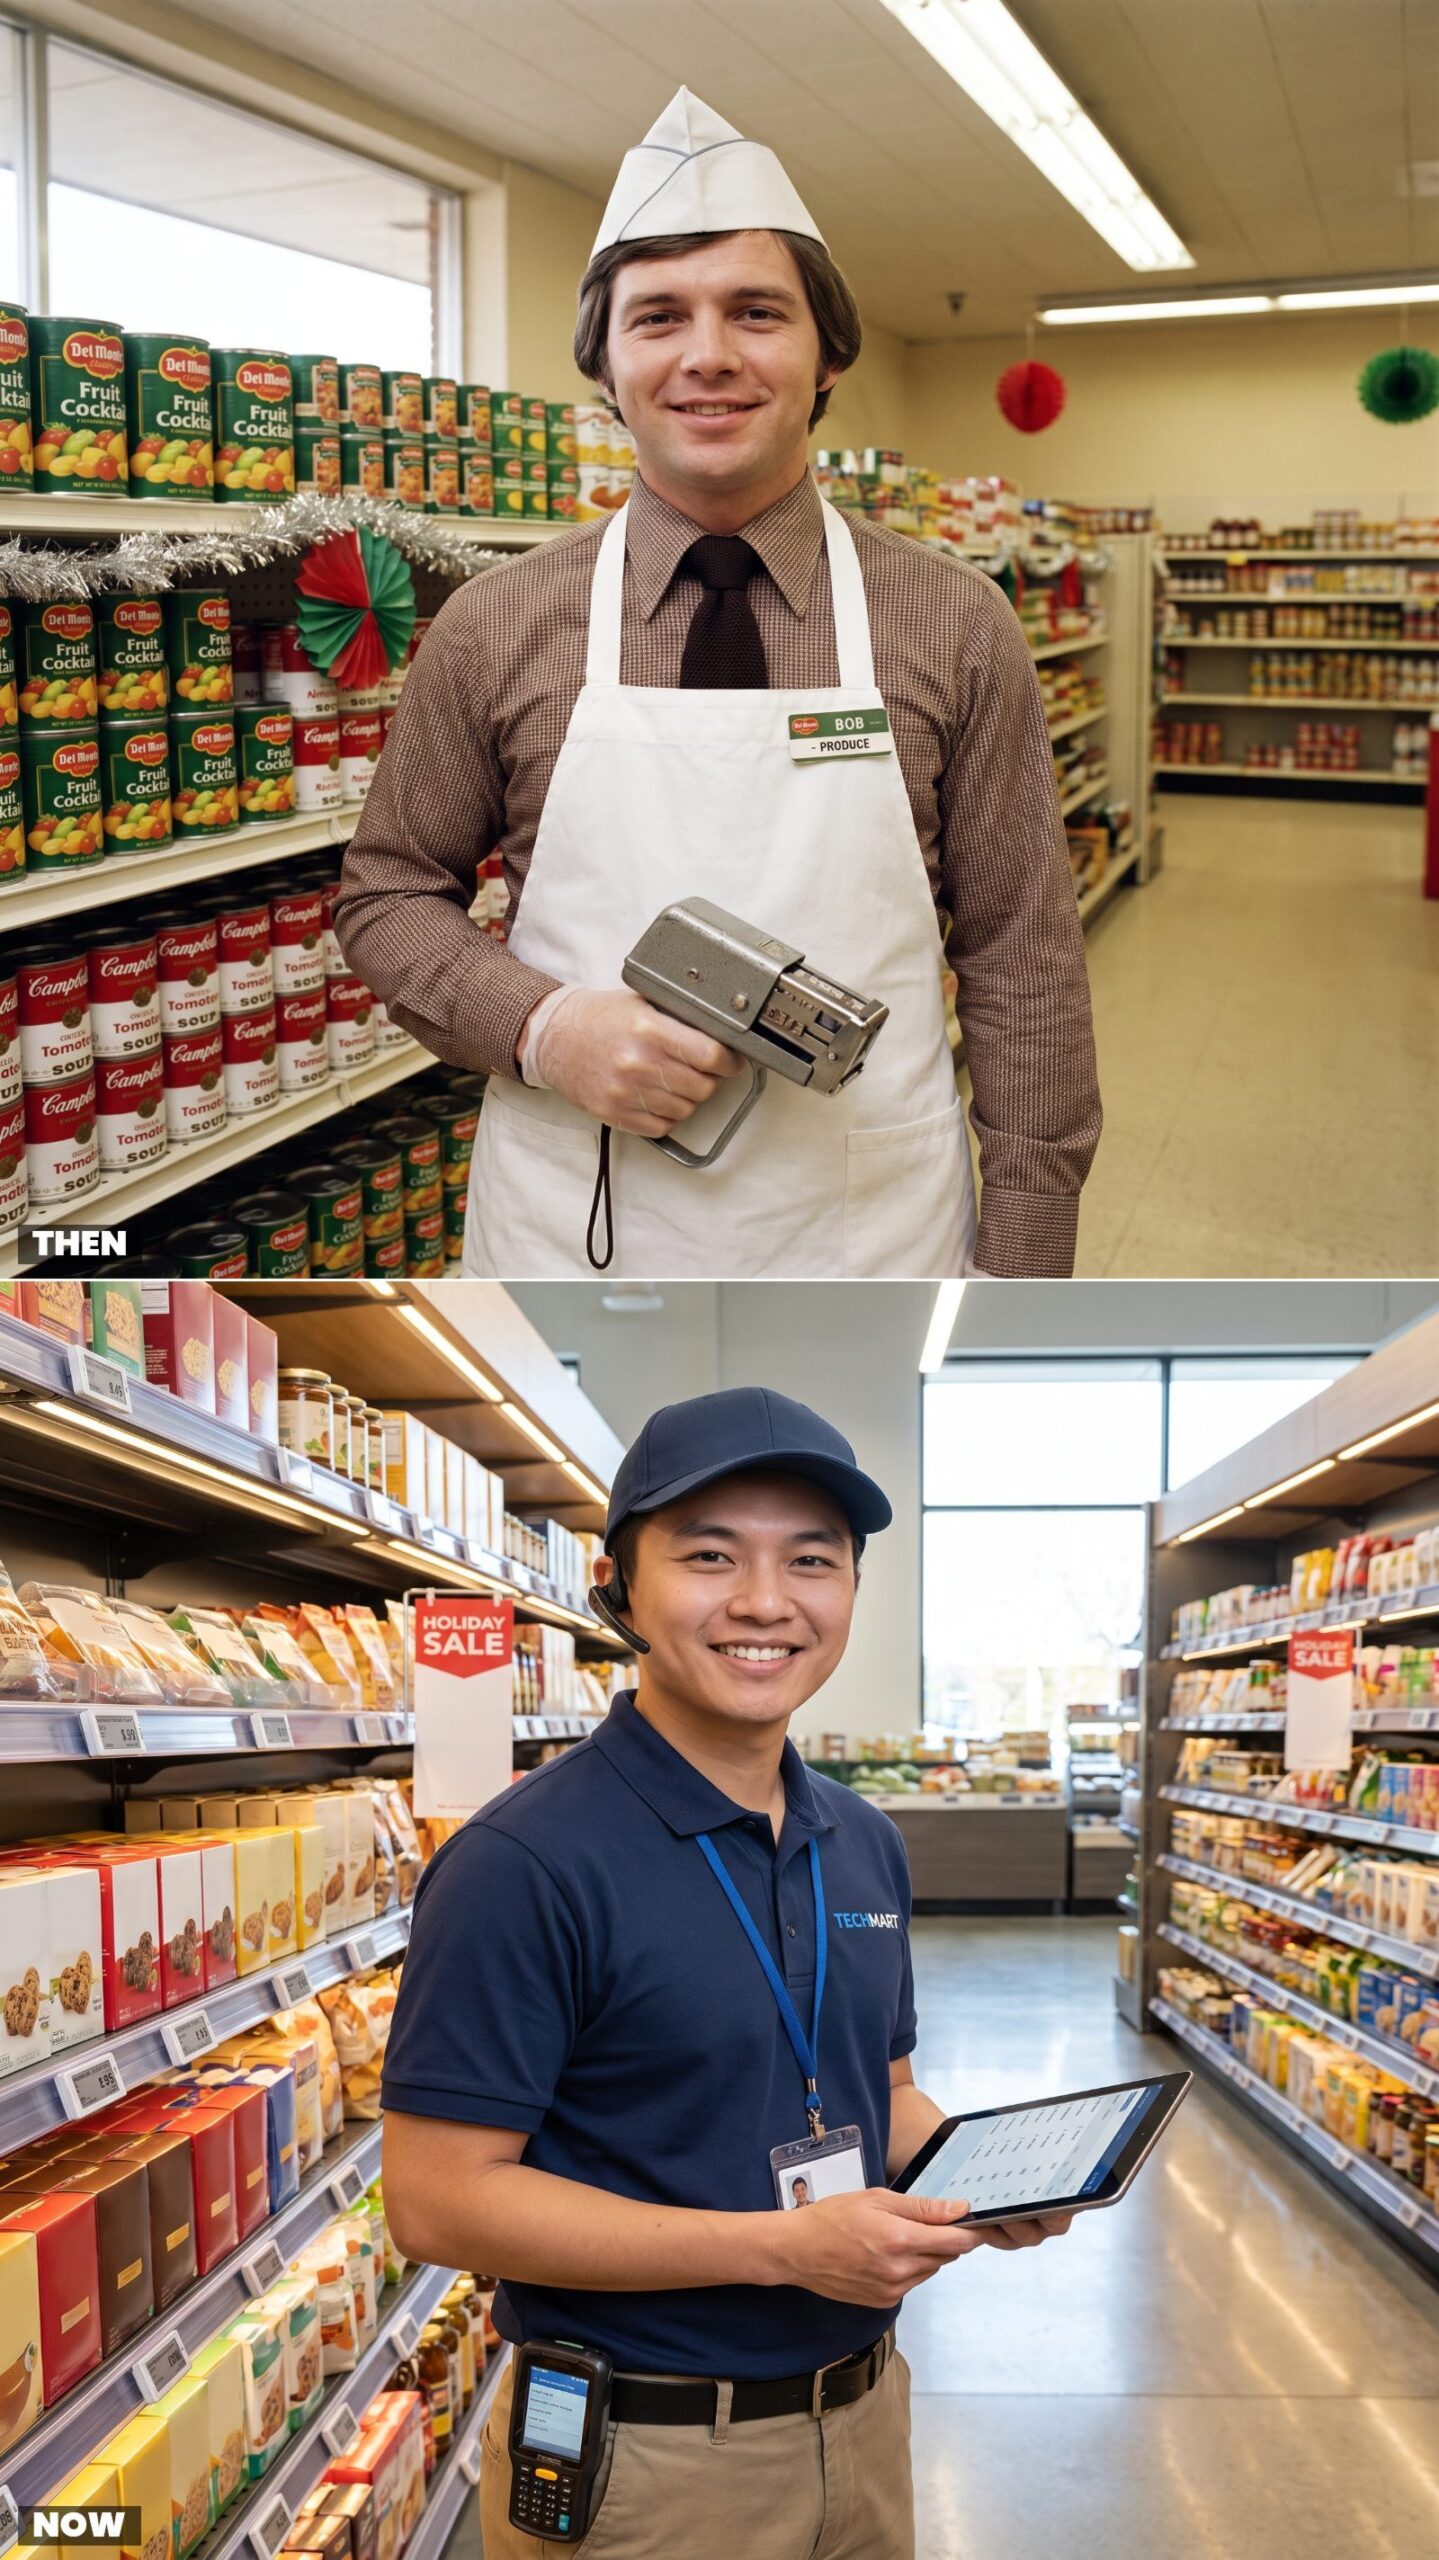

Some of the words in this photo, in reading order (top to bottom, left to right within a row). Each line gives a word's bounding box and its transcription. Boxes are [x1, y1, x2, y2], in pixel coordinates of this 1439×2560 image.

[70, 342, 93, 359] Del
[166, 358, 186, 371] Del
[0, 370, 23, 388] uit
[243, 371, 262, 383] Del
[0, 388, 30, 410] ktail
[79, 382, 121, 401] Fruit
[60, 399, 126, 421] Cocktai
[173, 395, 209, 412] Fruit
[250, 405, 287, 421] Fruit
[234, 420, 293, 438] Cocktai
[48, 615, 65, 625] Del
[120, 611, 136, 621] Del
[203, 607, 216, 618] Del
[127, 638, 158, 651] Fruit
[209, 633, 231, 646] Frui
[56, 642, 89, 656] Fruit
[115, 650, 164, 664] Cocktail
[43, 655, 95, 670] Cocktail
[260, 723, 274, 734] Del
[835, 717, 864, 731] BOB
[197, 733, 212, 744] Del
[820, 738, 870, 752] PRODUCE
[130, 744, 146, 753] Del
[59, 754, 75, 765] Del
[204, 757, 231, 770] Fruit
[139, 767, 166, 782] Fruit
[67, 779, 96, 793] Fruit
[126, 779, 170, 796] Cocktai
[54, 791, 100, 808] Cocktai
[0, 801, 23, 819] ktail
[240, 991, 272, 1007] SOUP
[177, 1011, 216, 1028] SOUP
[123, 1032, 160, 1051] SOUP
[52, 1054, 91, 1075] SOUP
[127, 1142, 164, 1162] SOUP
[64, 1168, 98, 1191] SOUP
[0, 1203, 26, 1225] OUP
[423, 1616, 506, 1630] HOLIDAY
[423, 1632, 504, 1655] SALE
[1295, 1650, 1346, 1667] SALE
[833, 1912, 898, 1929] TECHMART
